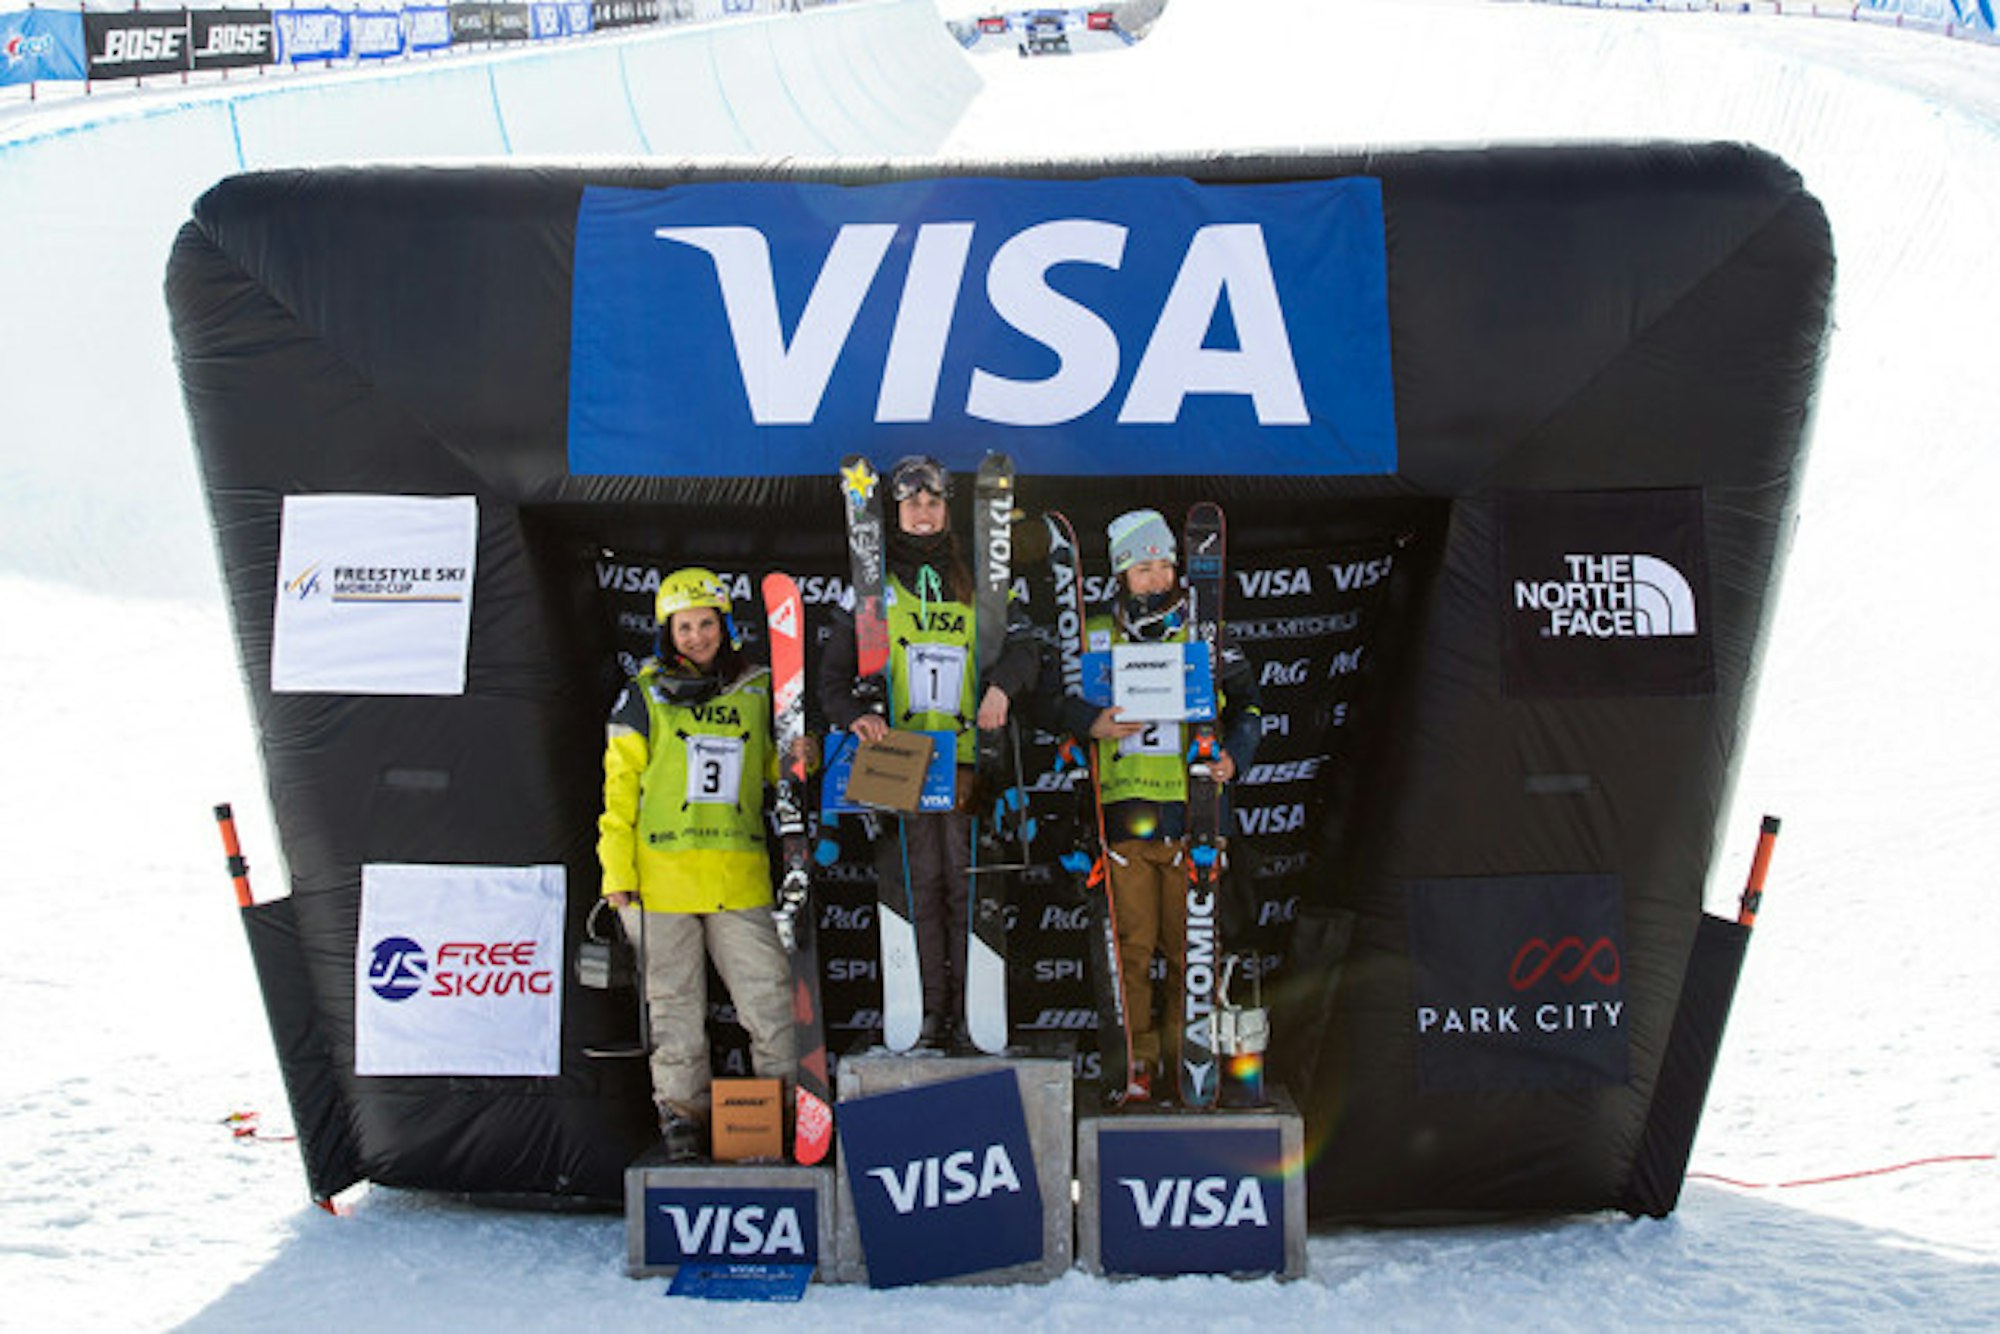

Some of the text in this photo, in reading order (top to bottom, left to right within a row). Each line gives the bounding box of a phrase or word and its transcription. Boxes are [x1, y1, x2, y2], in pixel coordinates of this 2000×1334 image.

[92, 27, 187, 63] BOSE
[194, 24, 271, 57] BOSE
[654, 218, 1312, 426] VISA
[334, 567, 466, 582] FREESTYLE SKI
[596, 562, 660, 593] VISA
[1236, 567, 1312, 598] VISA
[1564, 555, 1632, 582] THE
[1514, 582, 1632, 610] NORTH
[909, 612, 966, 634] VISA
[1551, 611, 1635, 636] FACE
[930, 669, 938, 700] 1
[1259, 659, 1311, 686] P&G
[691, 705, 741, 727] VISA
[1141, 722, 1160, 747] 2
[703, 762, 721, 794] 3
[1234, 804, 1305, 835] VISA
[820, 904, 873, 930] P&G
[1039, 903, 1090, 930] P&G
[437, 941, 538, 966] FREE
[429, 971, 554, 997] SKIING
[1035, 959, 1083, 981] SPI
[1186, 889, 1215, 1050] ATOMIC
[1418, 1001, 1624, 1033] PARK CITY
[865, 1143, 1022, 1215] VISA
[1117, 1176, 1269, 1228] VISA
[658, 1204, 805, 1256] VISA
